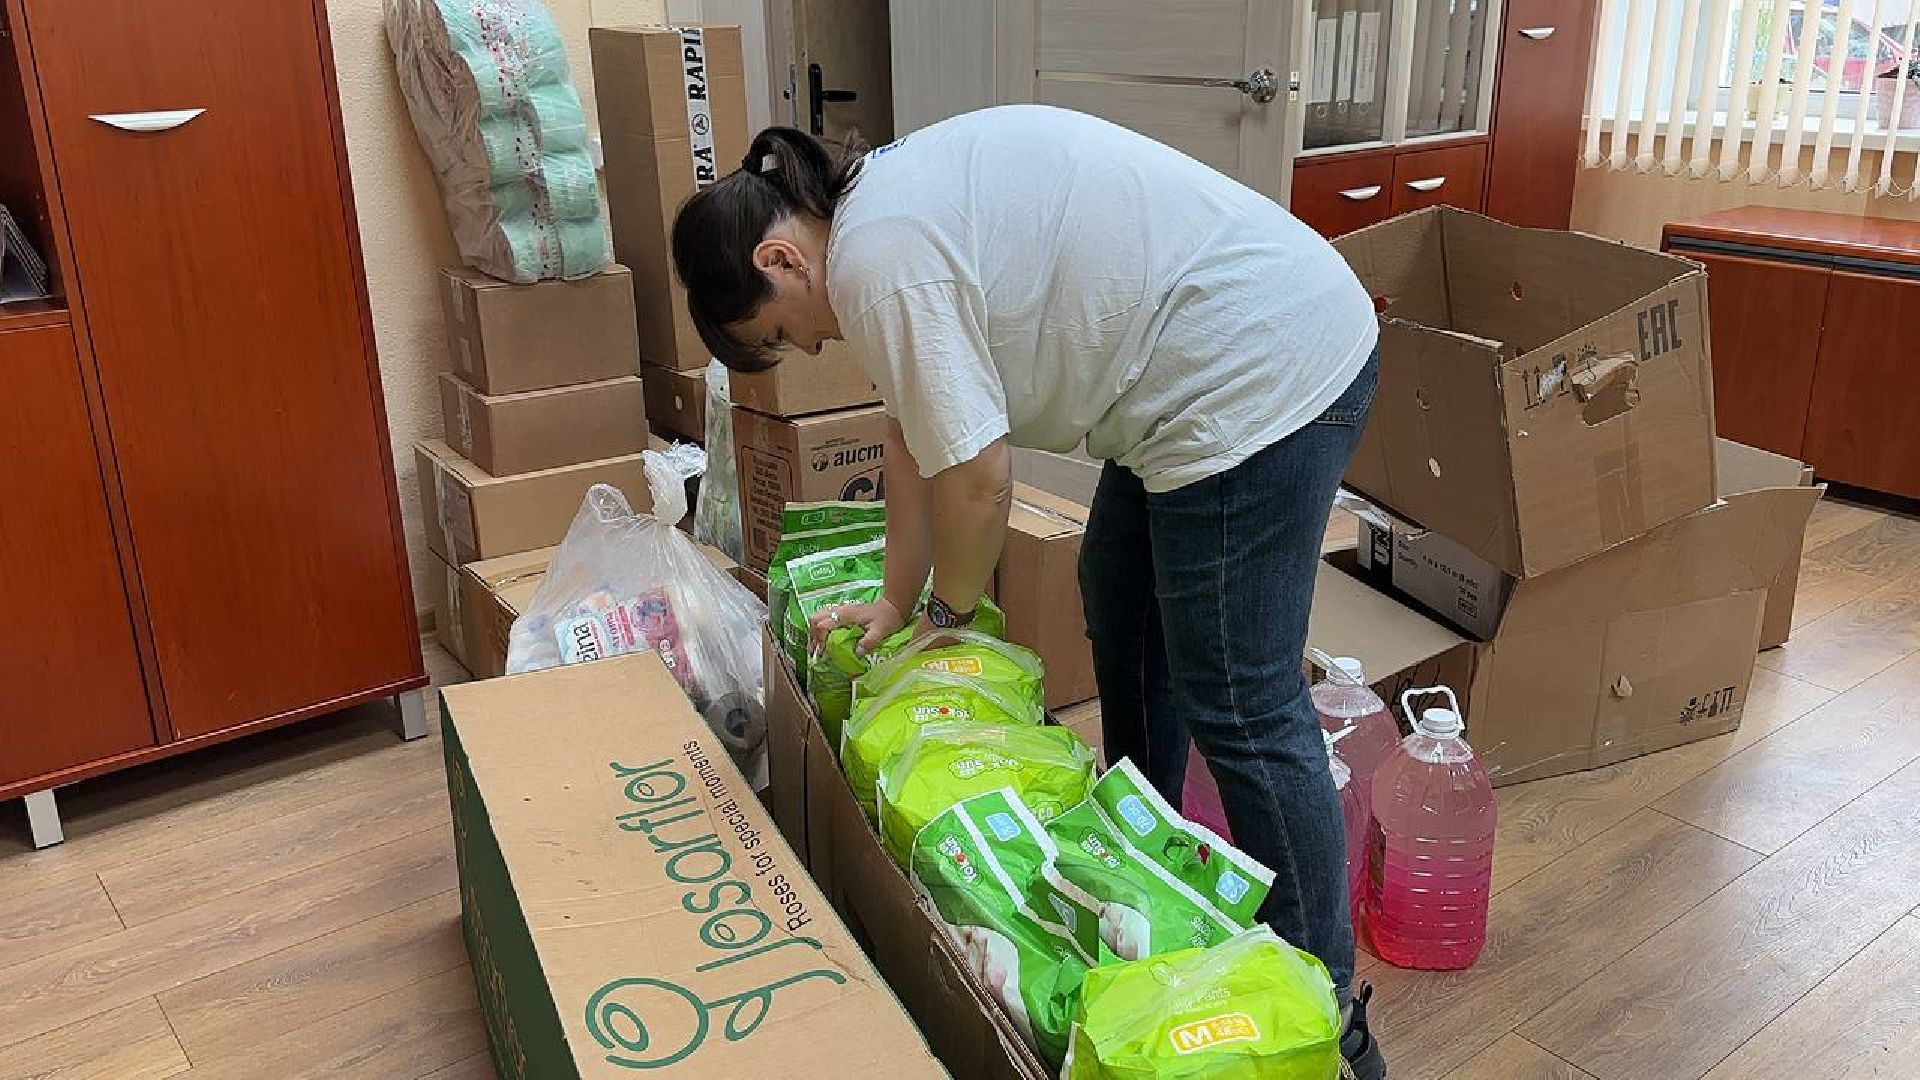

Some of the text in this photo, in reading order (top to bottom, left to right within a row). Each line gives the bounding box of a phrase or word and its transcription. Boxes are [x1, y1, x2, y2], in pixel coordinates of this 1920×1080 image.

[683, 740, 812, 931] Roses for special moments
[1179, 1024, 1214, 1048] M
